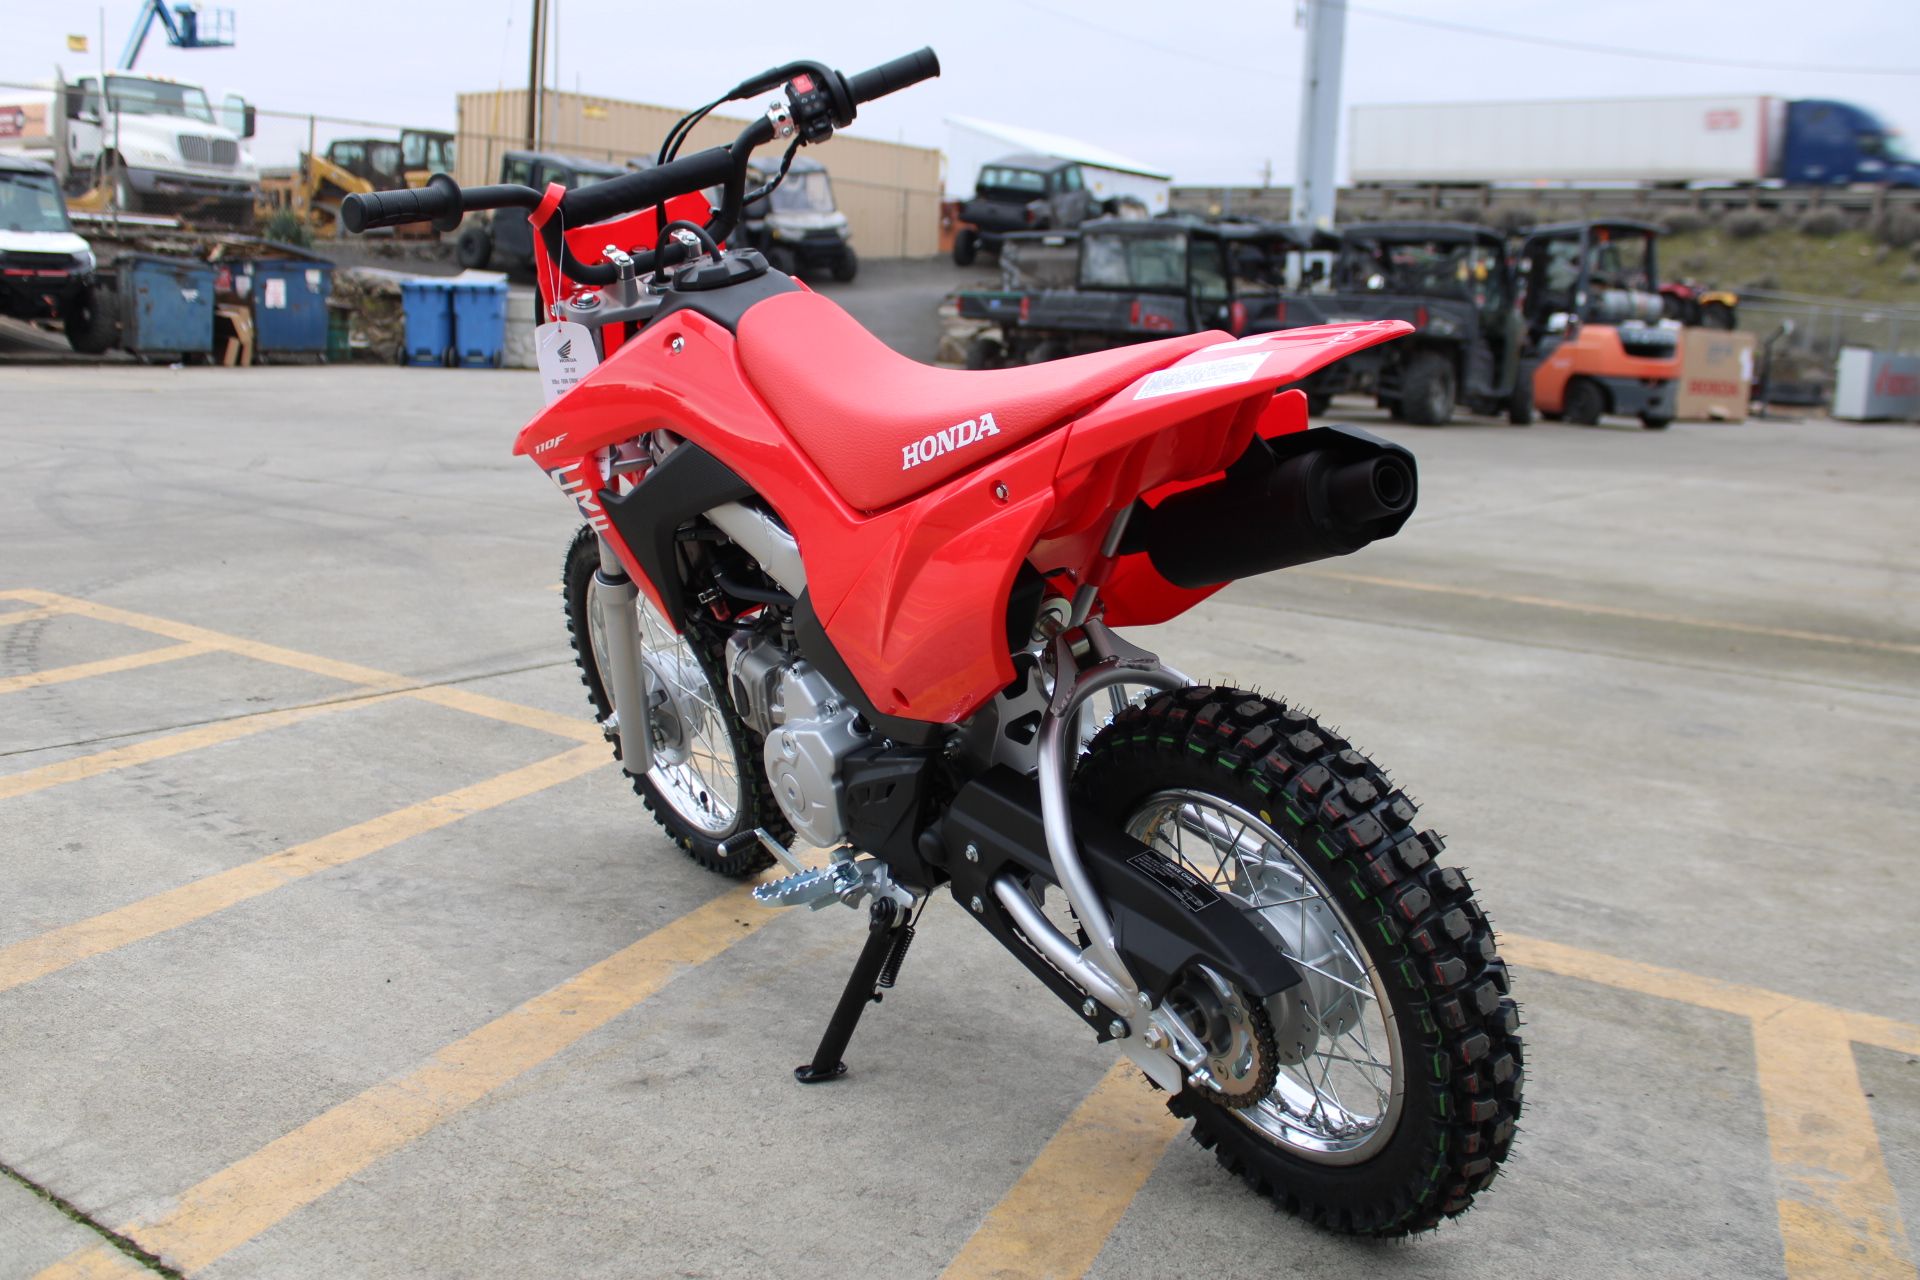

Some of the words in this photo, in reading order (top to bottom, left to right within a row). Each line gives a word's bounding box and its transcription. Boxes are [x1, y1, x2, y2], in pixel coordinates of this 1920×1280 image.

[535, 432, 568, 454] 110F
[902, 412, 1000, 470] HONDA
[1166, 862, 1181, 873] DRIVE
[1181, 873, 1198, 885] CHAIN
